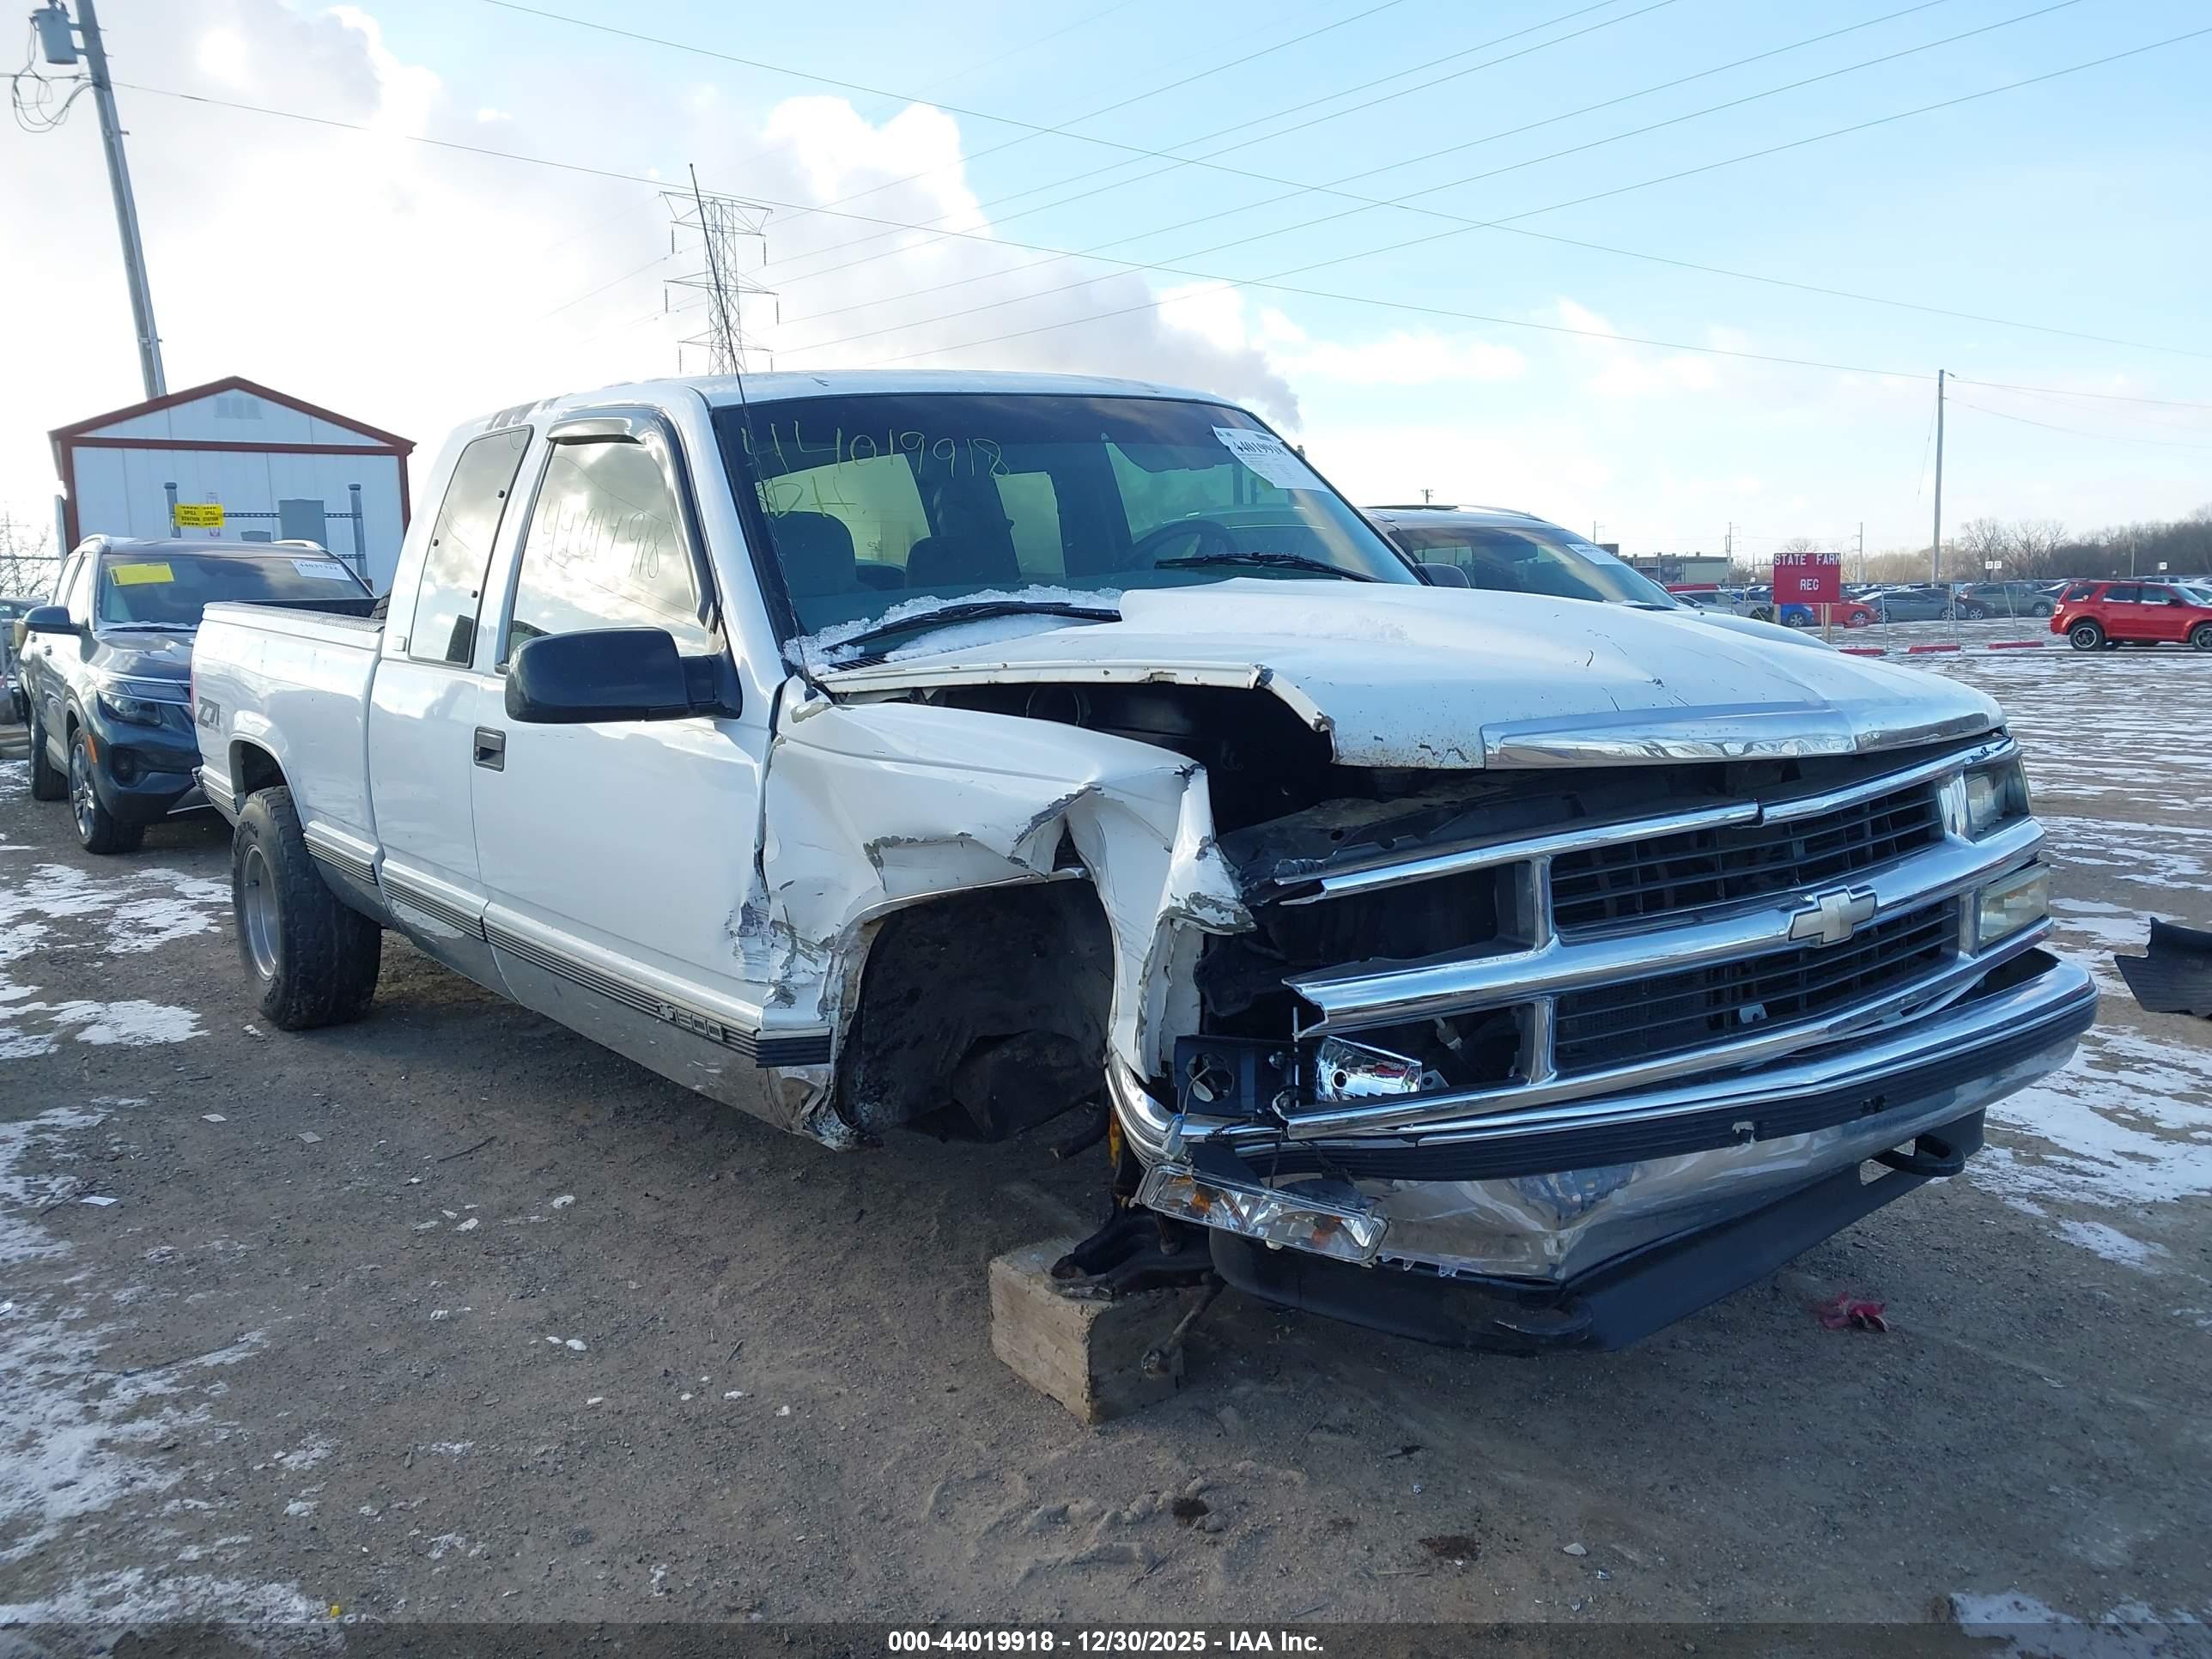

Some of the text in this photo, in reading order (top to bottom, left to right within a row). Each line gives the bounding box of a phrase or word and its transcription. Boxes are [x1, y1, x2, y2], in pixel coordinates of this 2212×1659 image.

[739, 419, 1011, 479] 44019918
[1774, 554, 1841, 566] STATE FARM
[1800, 578, 1820, 591] REG
[198, 696, 221, 729] Z71
